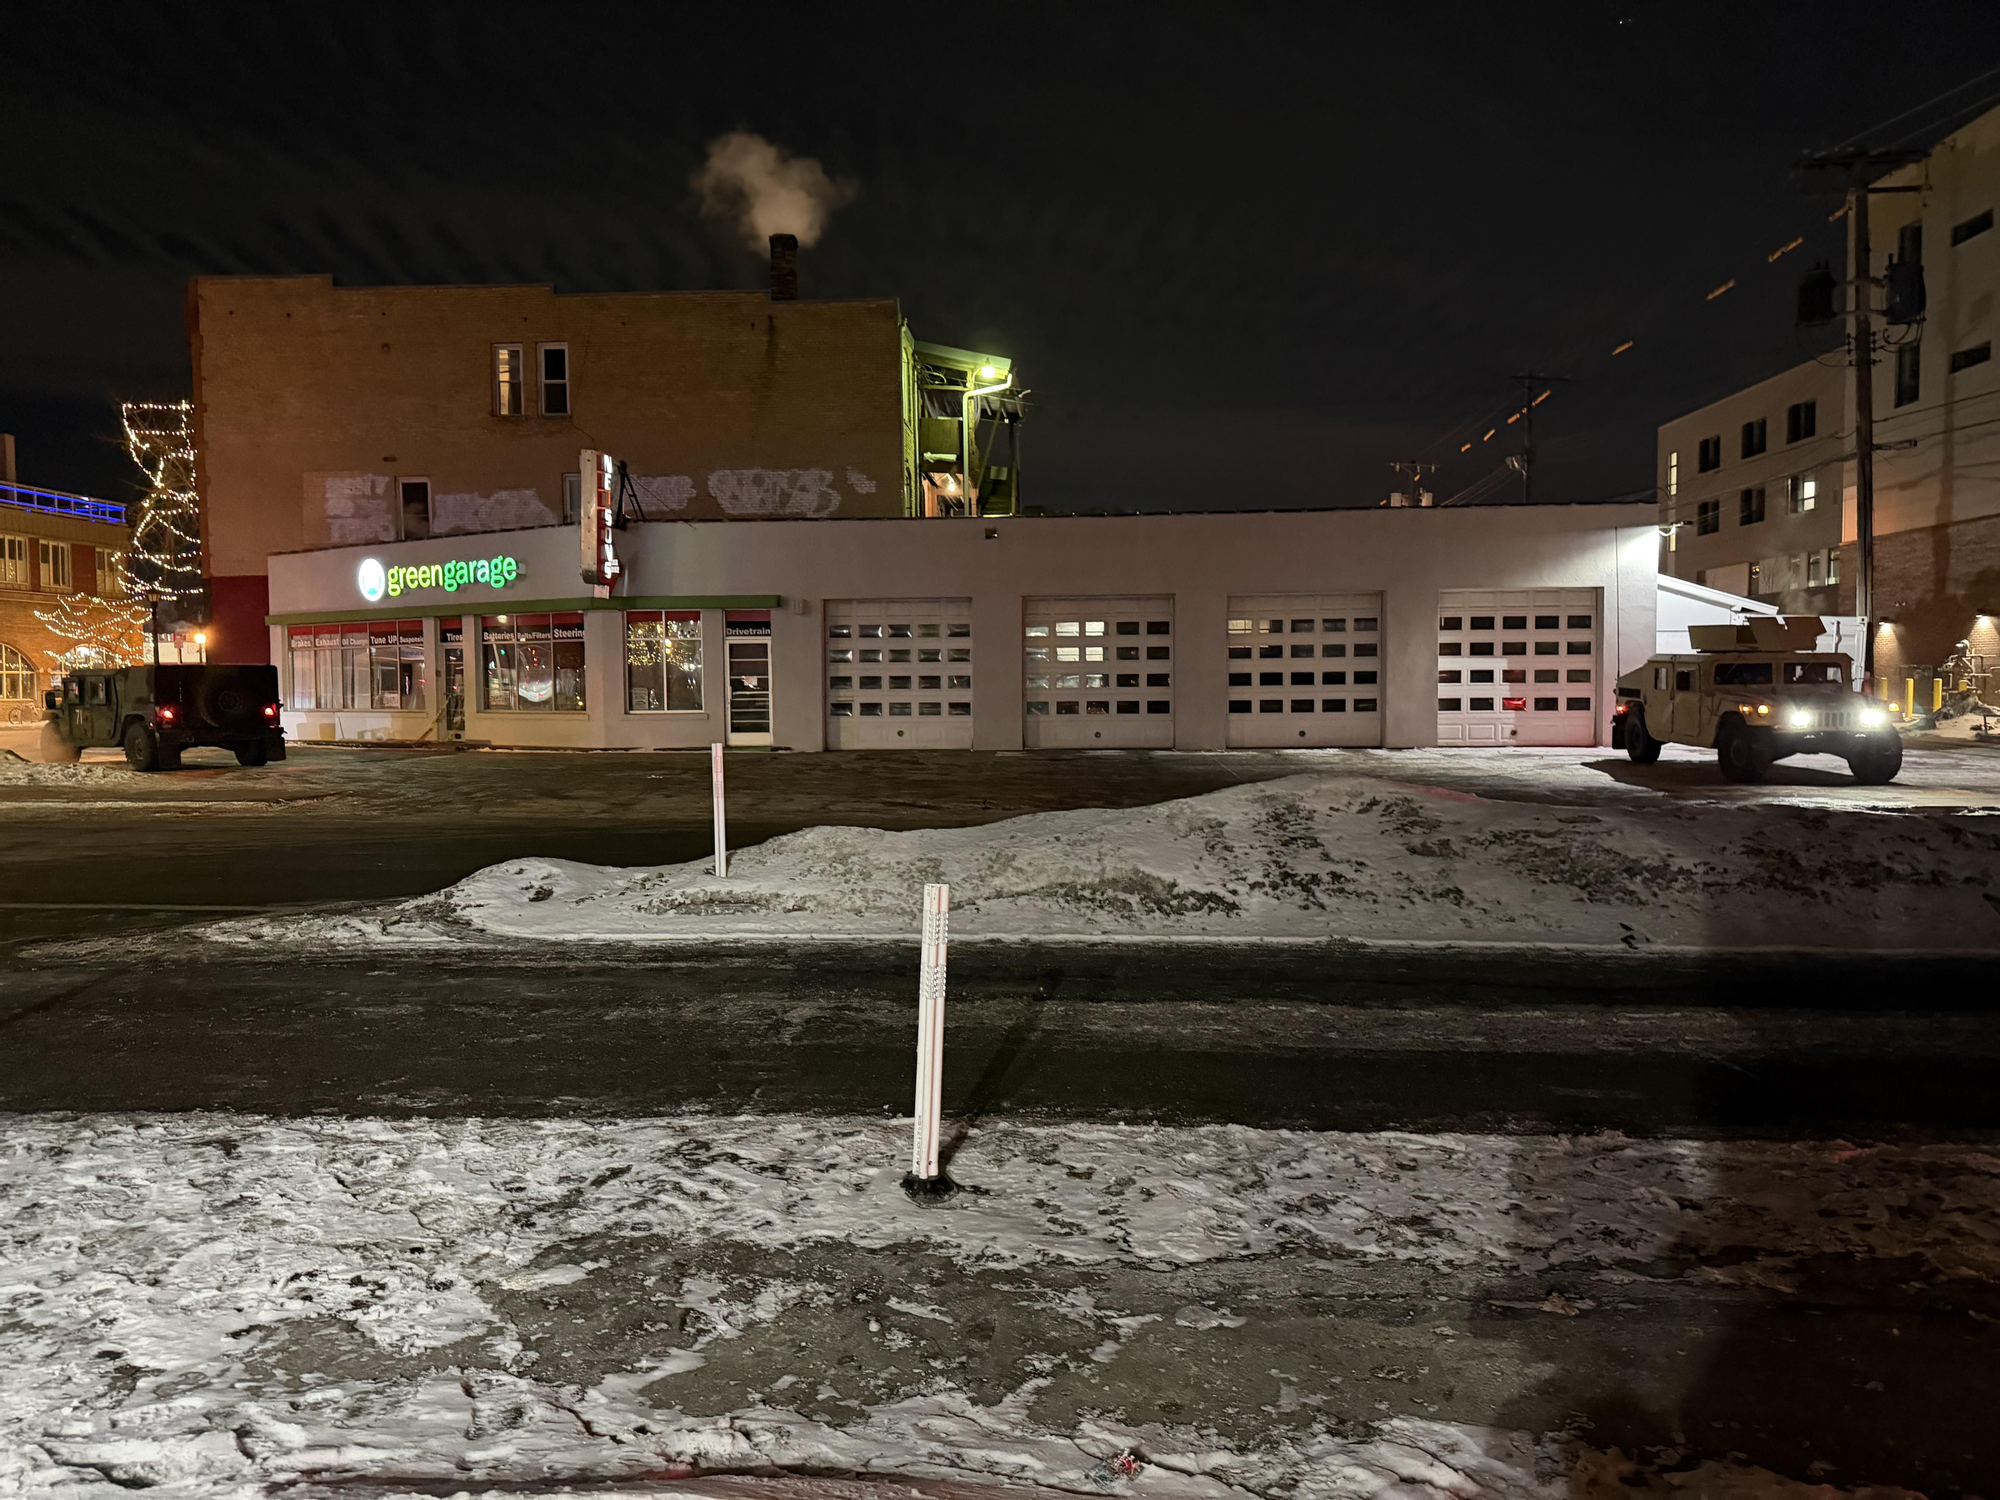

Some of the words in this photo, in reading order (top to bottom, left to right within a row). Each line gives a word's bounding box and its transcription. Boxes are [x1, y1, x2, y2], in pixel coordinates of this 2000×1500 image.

[603, 454, 614, 579] NESONS
[387, 555, 517, 597] greengarage
[484, 631, 515, 641] Batteries
[726, 627, 771, 636] Drivetrain
[315, 638, 339, 646] Exhaust
[370, 635, 386, 645] Tune
[446, 633, 464, 641] Tires
[292, 638, 311, 648] Brakes
